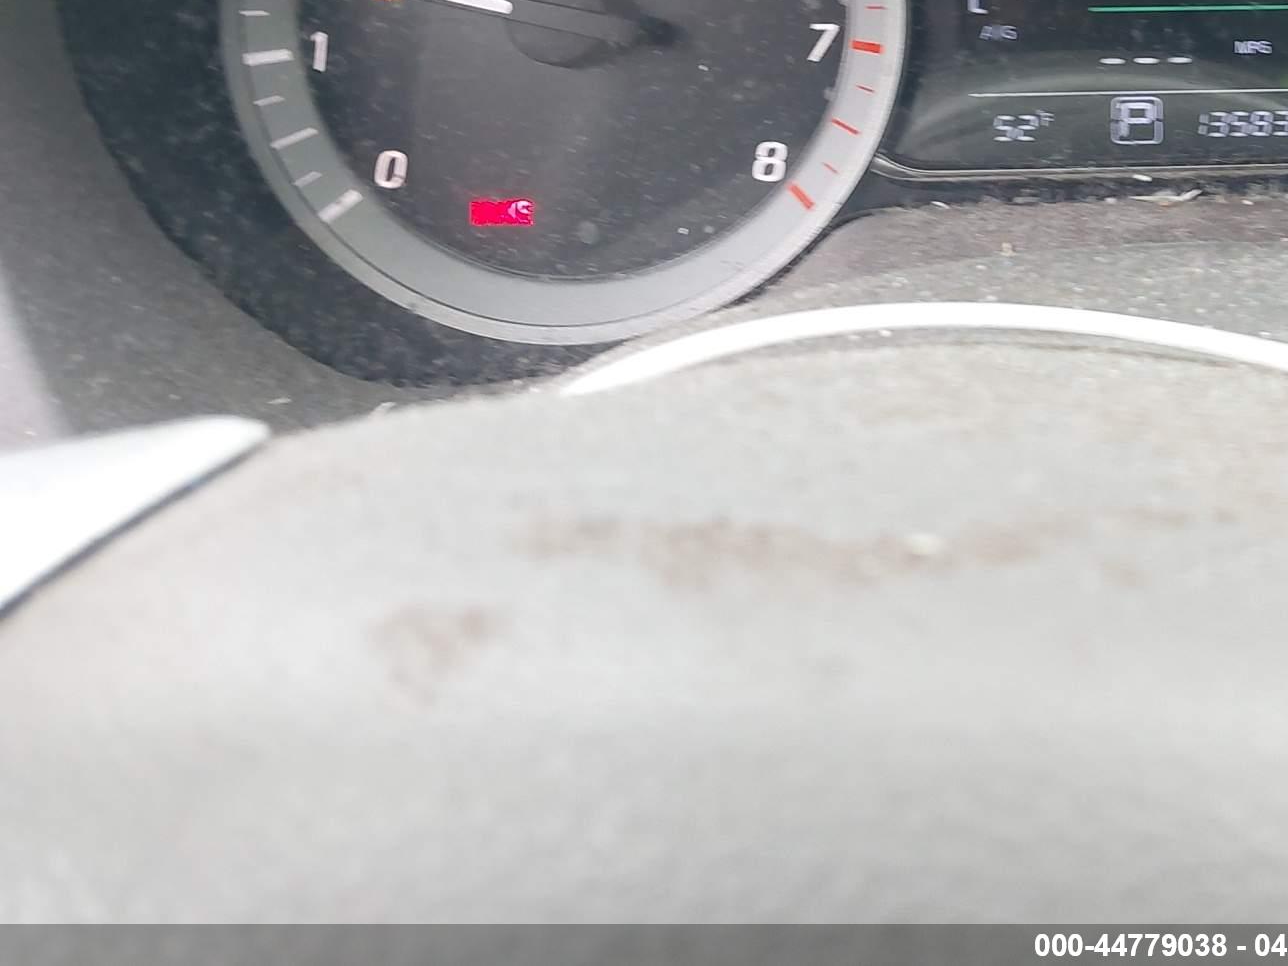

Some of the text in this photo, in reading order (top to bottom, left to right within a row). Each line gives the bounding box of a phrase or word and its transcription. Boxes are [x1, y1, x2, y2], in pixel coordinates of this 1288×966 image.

[310, 31, 329, 72] 1
[806, 22, 841, 63] 7
[1116, 101, 1157, 138] P
[374, 149, 408, 189] 0
[751, 140, 789, 181] 8
